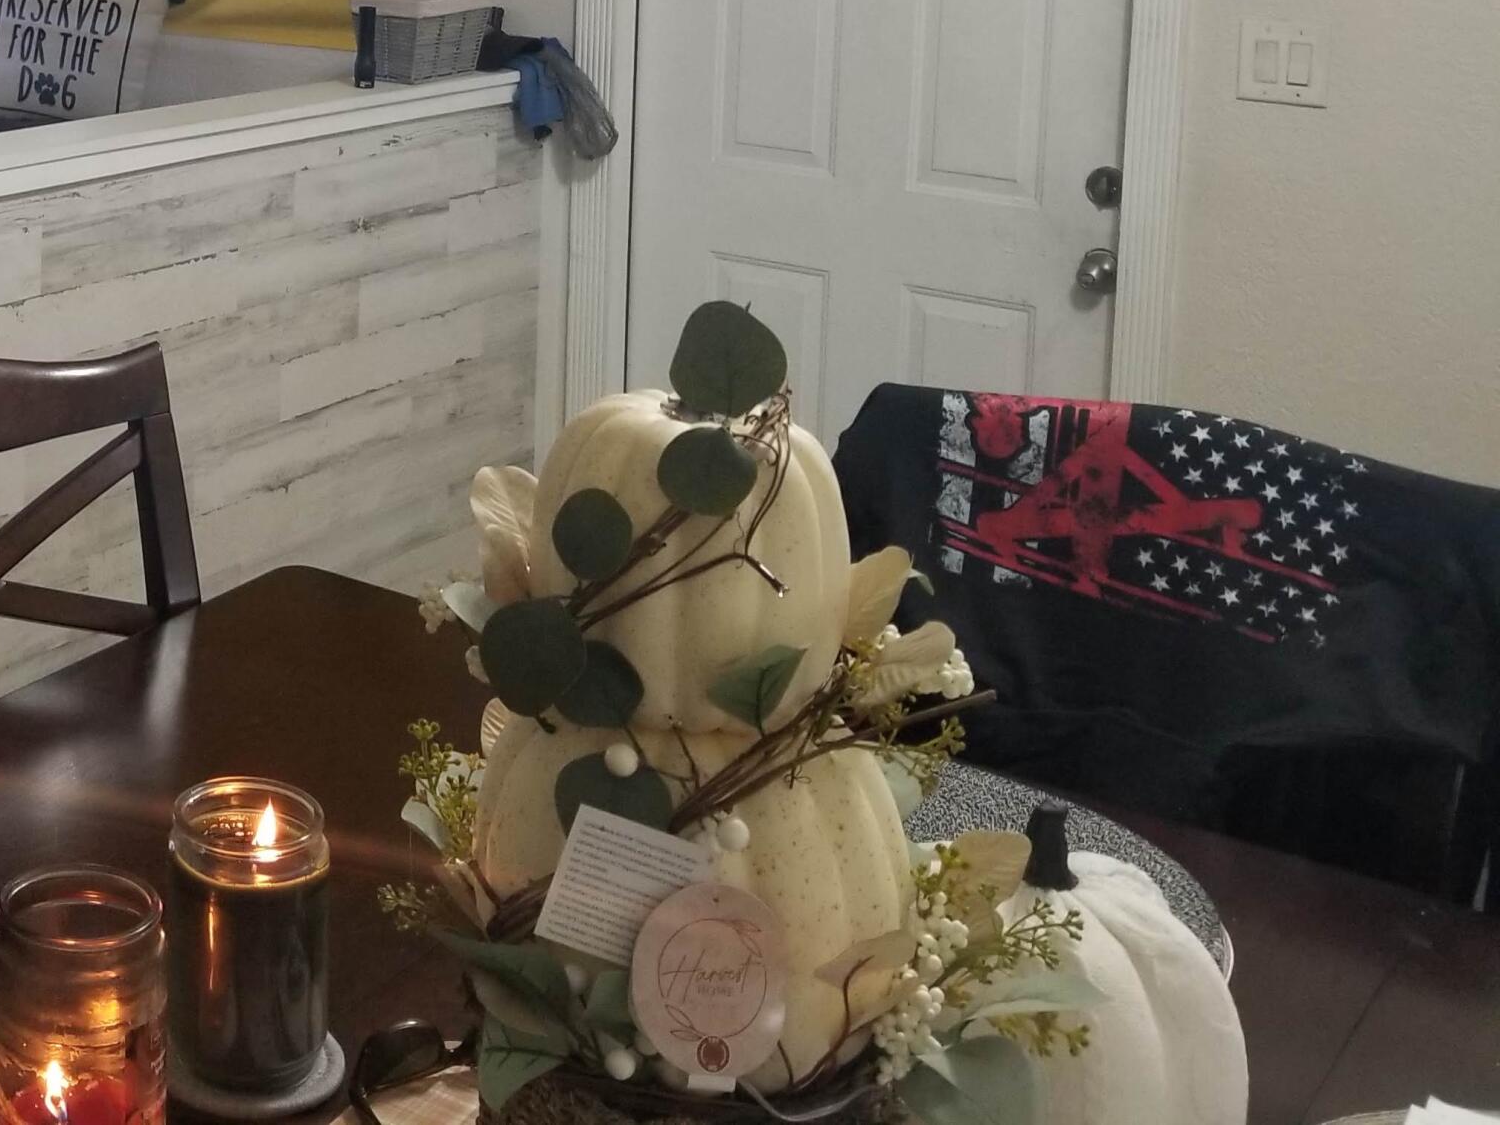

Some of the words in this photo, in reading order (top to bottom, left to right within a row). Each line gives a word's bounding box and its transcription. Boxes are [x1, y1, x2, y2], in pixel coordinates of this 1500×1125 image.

[8, 24, 46, 65] FOR
[59, 32, 103, 75] THE
[17, 65, 77, 111] DG
[660, 949, 762, 1005] Harvest
